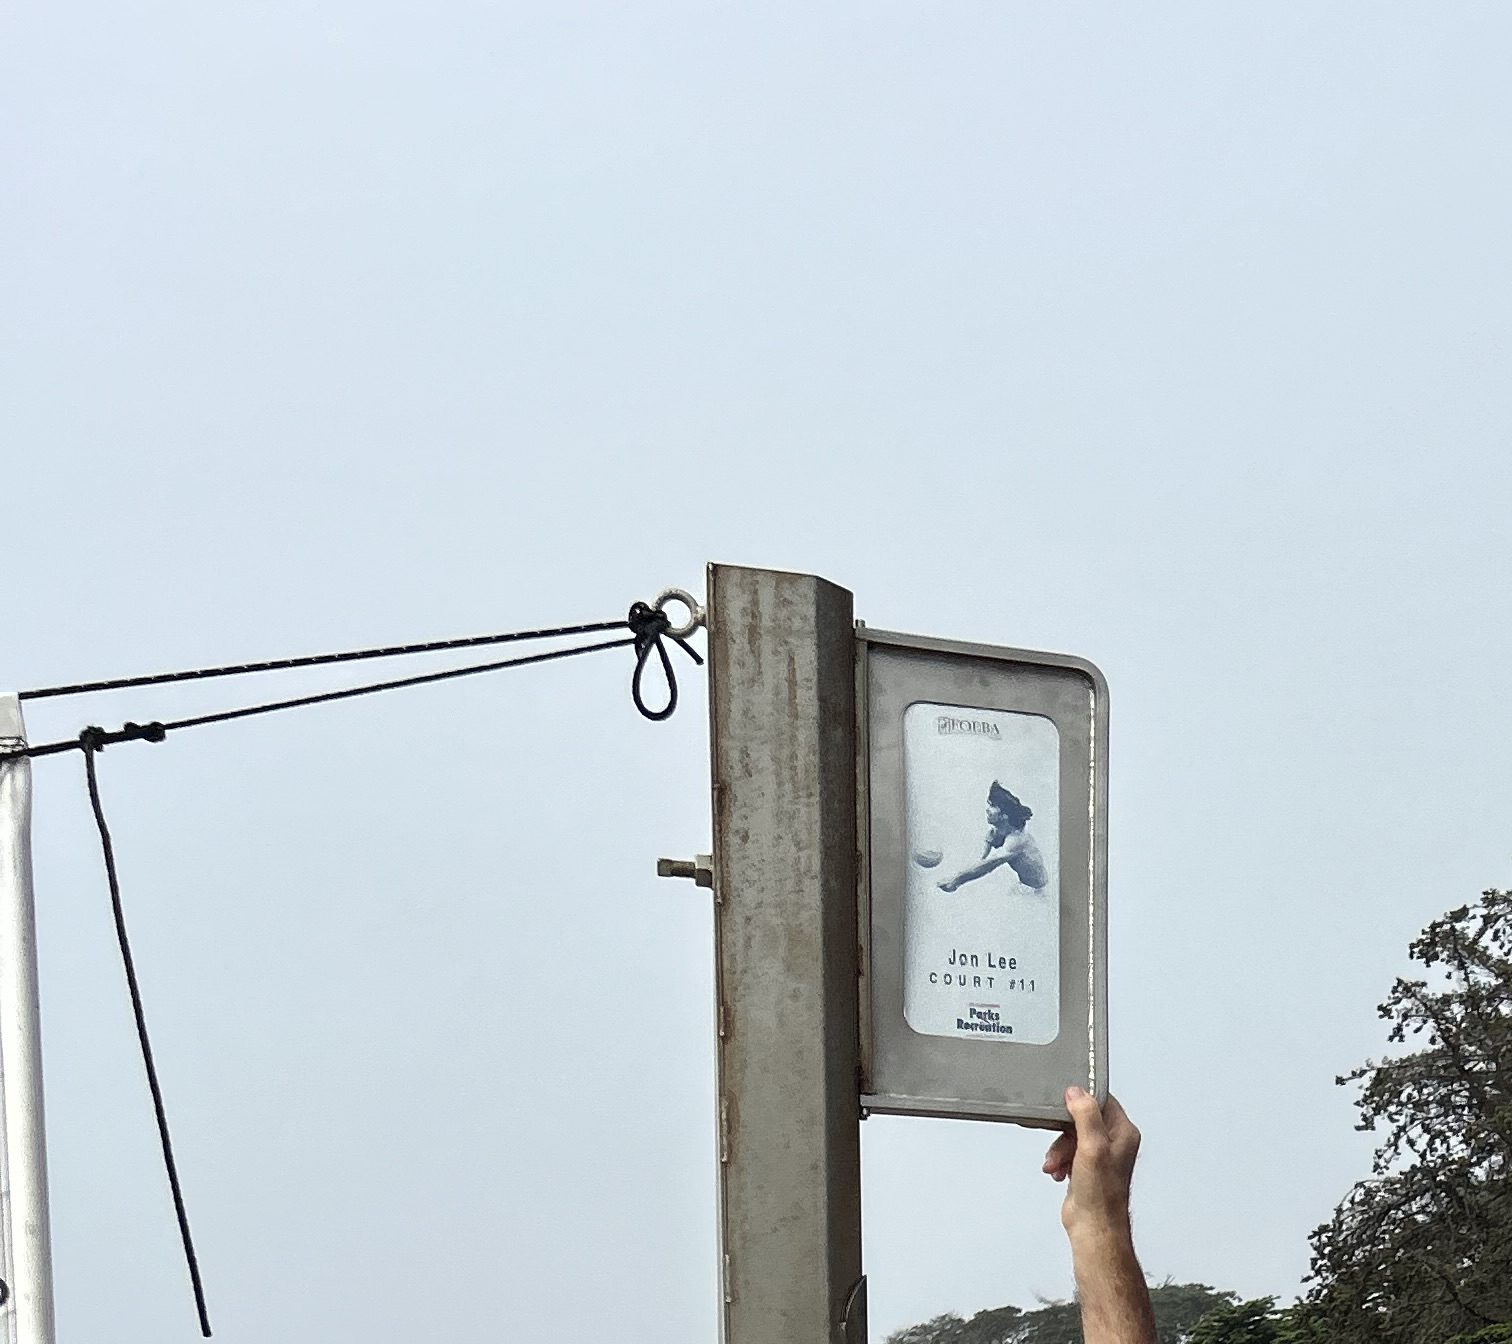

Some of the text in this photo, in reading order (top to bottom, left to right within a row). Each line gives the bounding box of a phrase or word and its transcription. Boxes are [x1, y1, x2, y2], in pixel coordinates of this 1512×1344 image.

[948, 949, 1017, 970] Jon Lee
[929, 971, 1035, 992] COURT #11
[969, 1007, 1000, 1021] Parks
[956, 1018, 1013, 1034] Recreation
